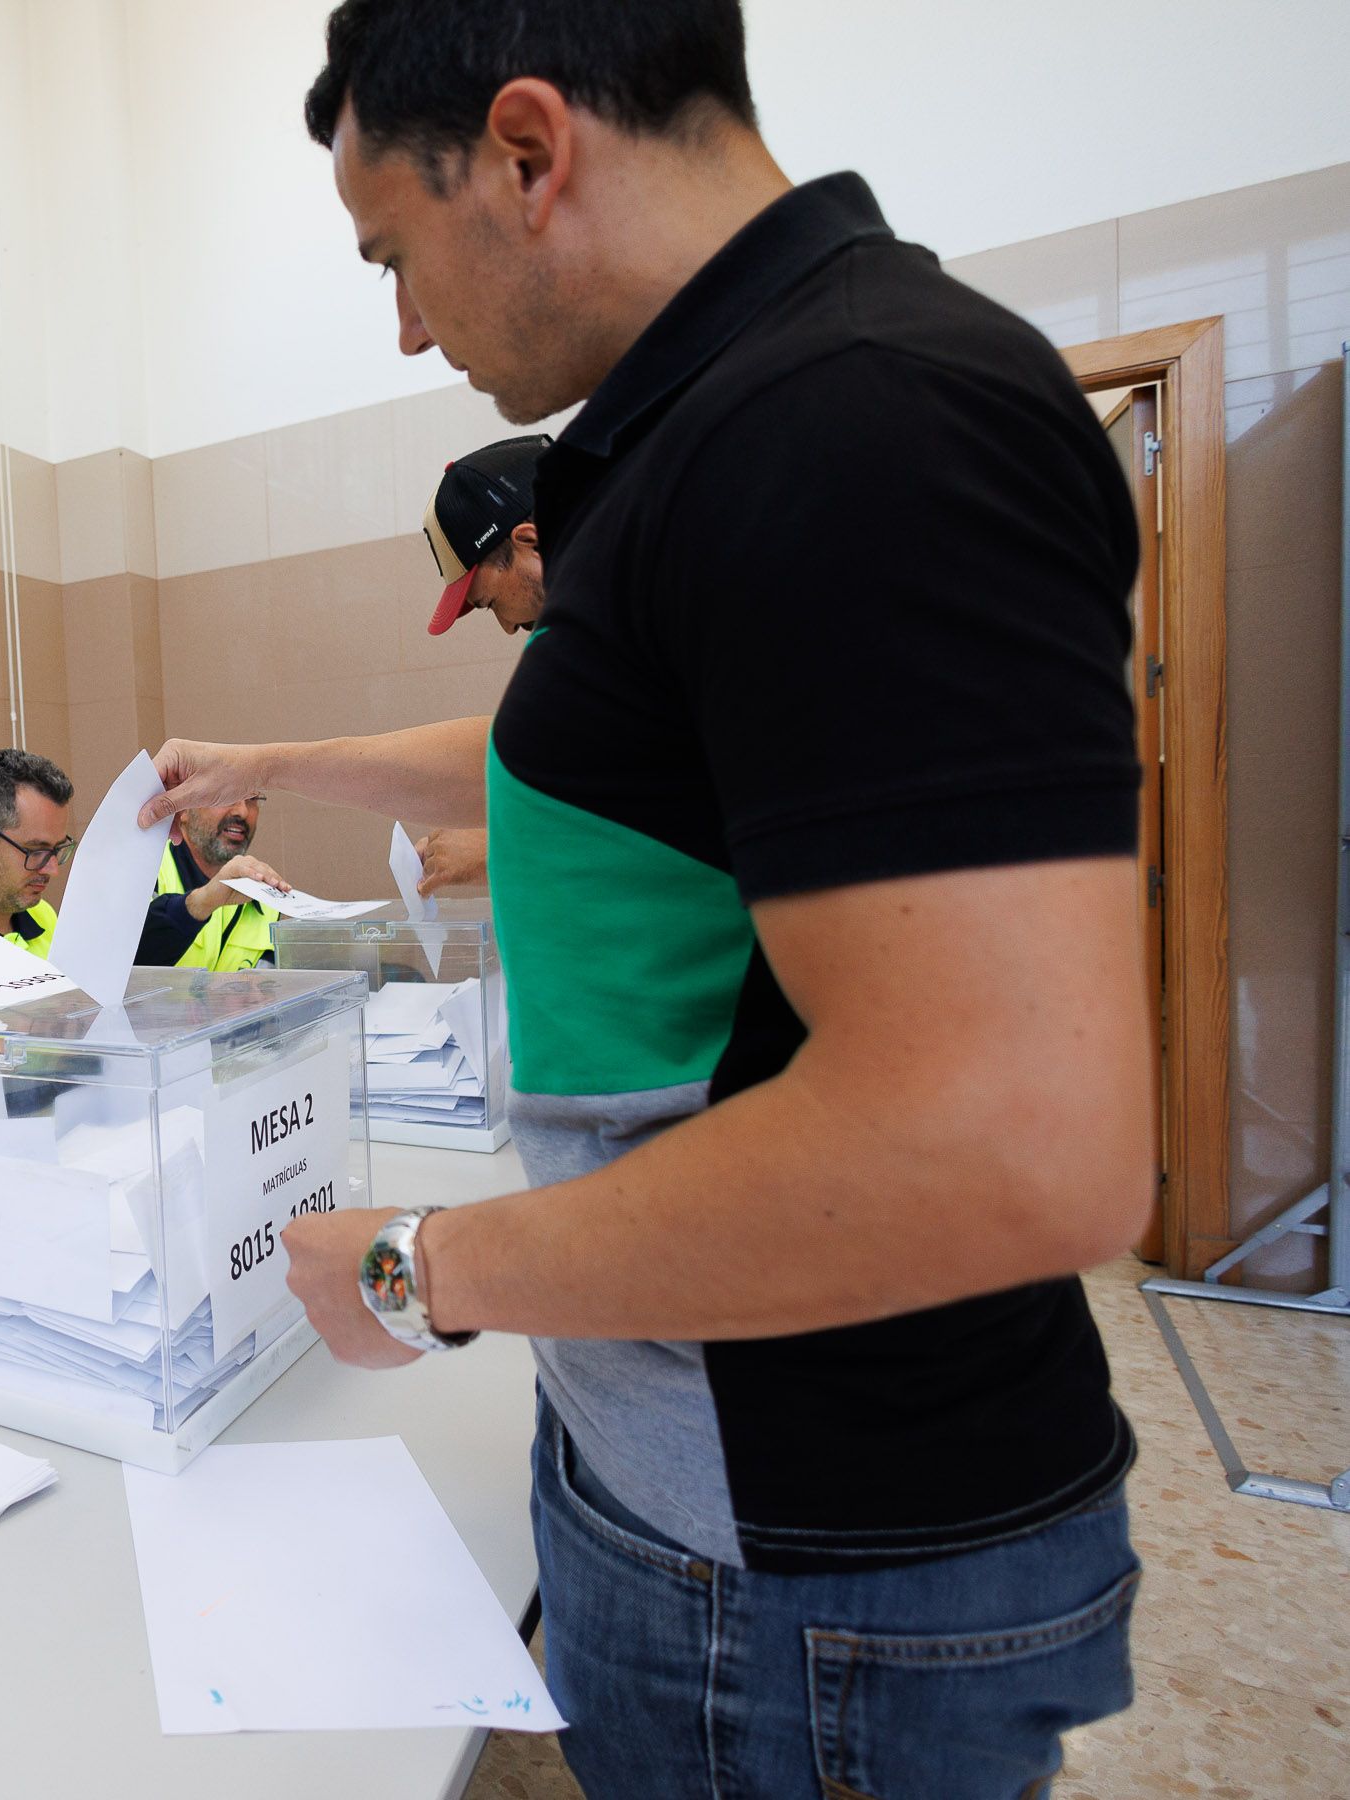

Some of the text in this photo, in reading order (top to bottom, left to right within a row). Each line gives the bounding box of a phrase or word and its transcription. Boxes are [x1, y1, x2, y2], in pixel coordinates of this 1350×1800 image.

[251, 1092, 314, 1155] MESA 2
[262, 1158, 308, 1196] MATRÍCULAS
[230, 1220, 275, 1281] 8015
